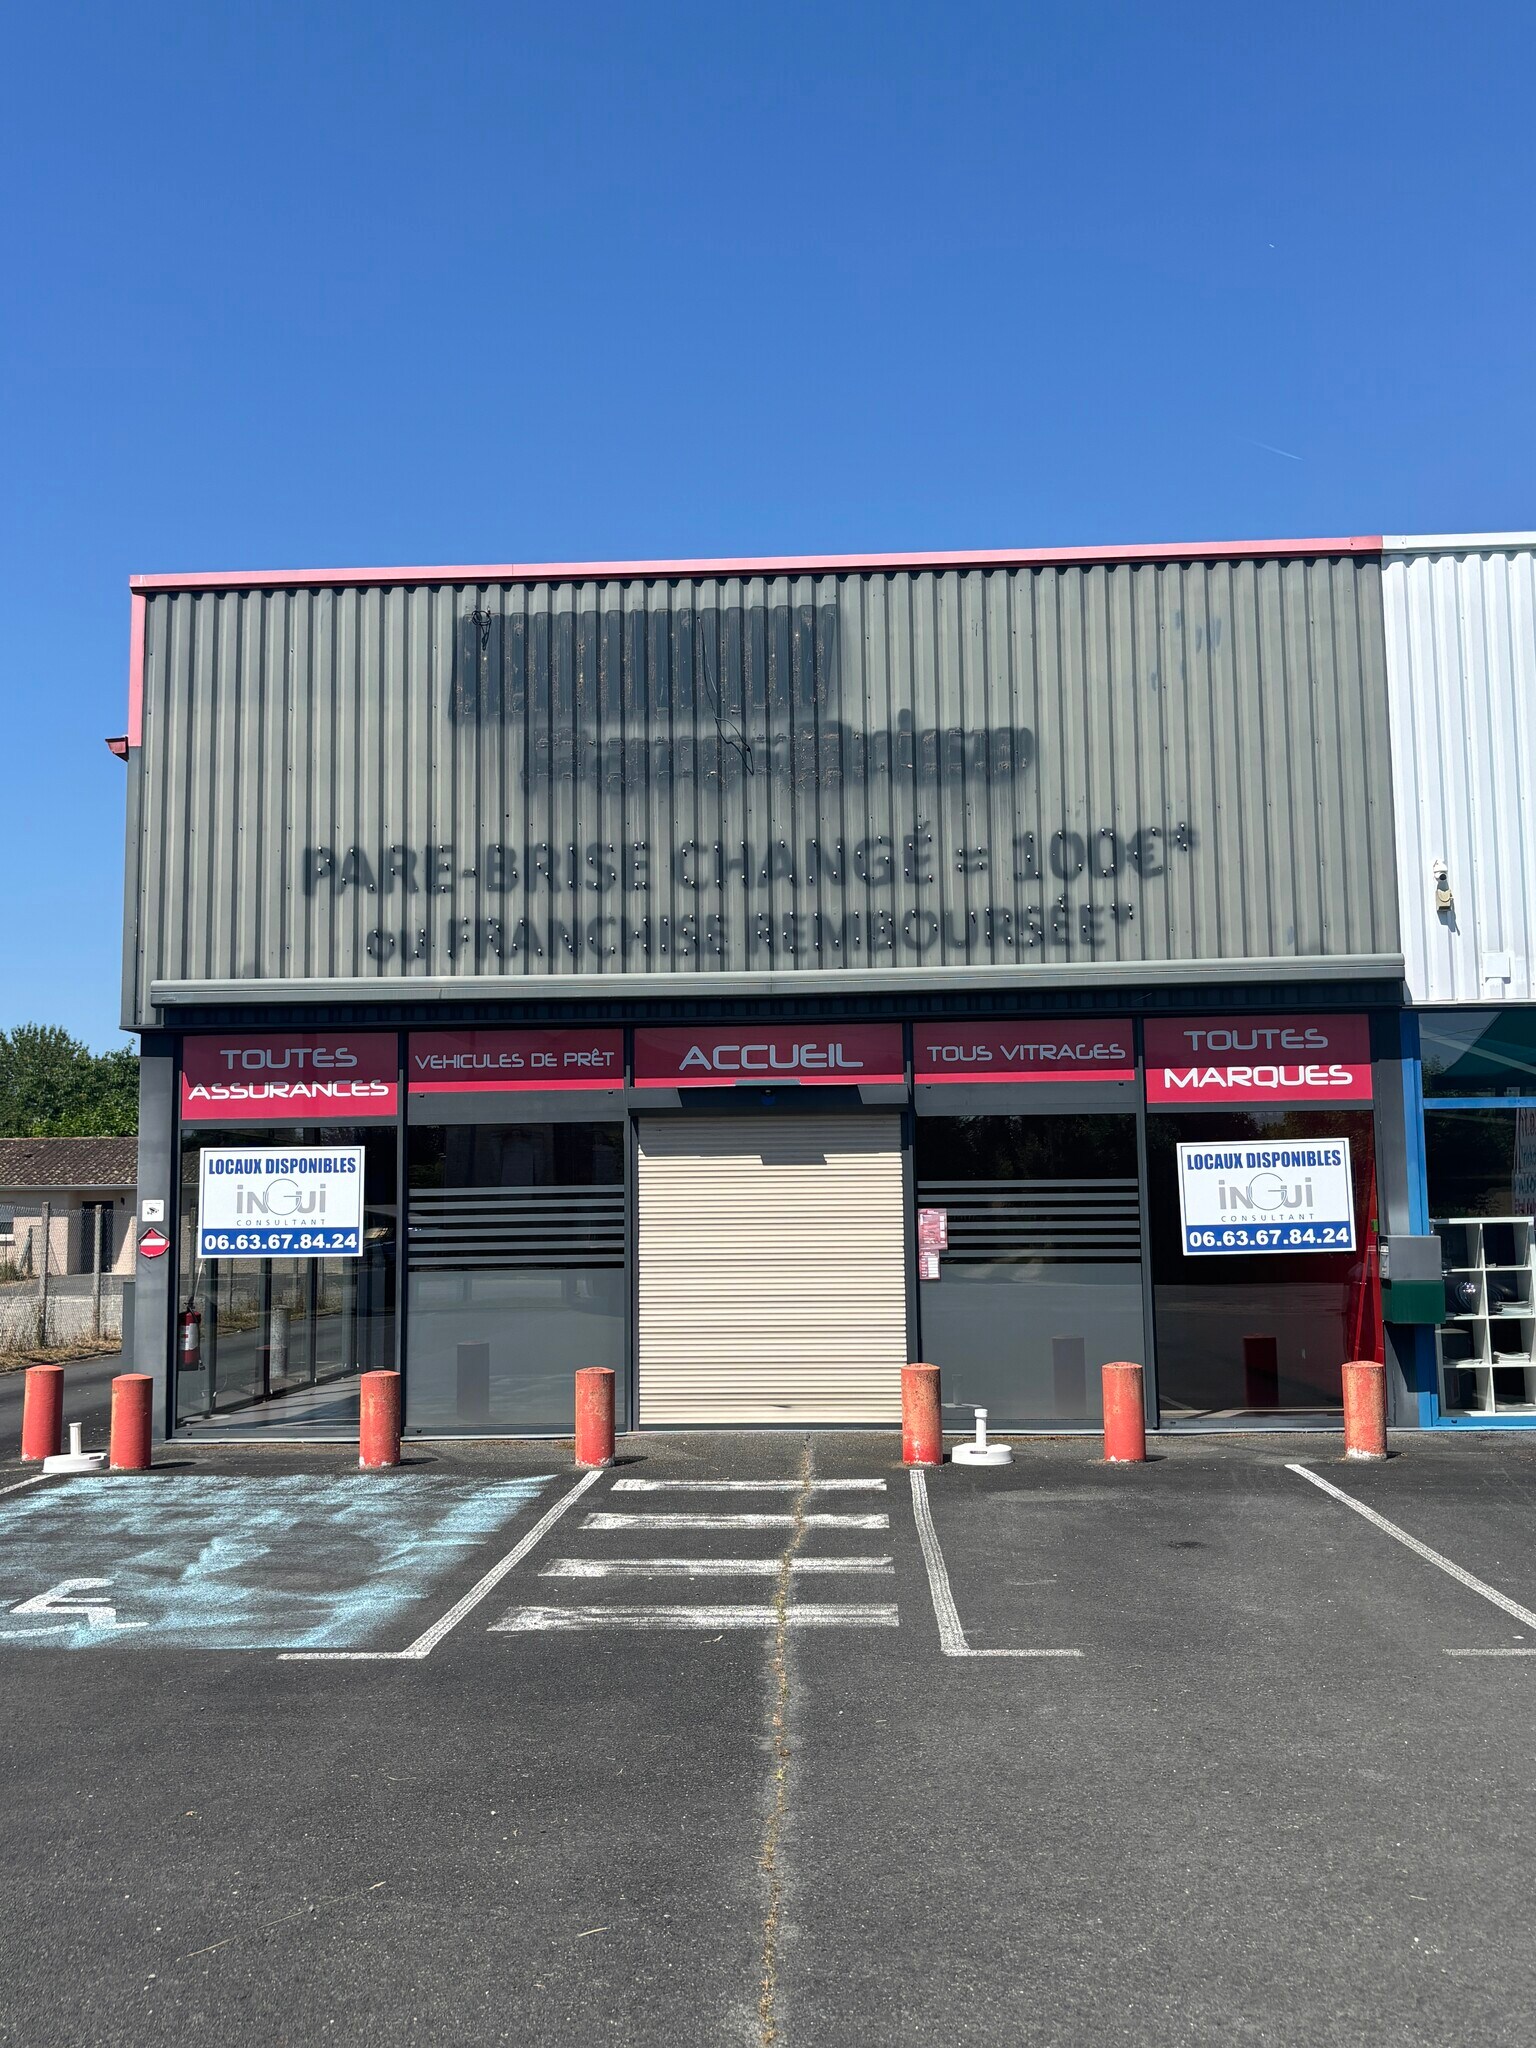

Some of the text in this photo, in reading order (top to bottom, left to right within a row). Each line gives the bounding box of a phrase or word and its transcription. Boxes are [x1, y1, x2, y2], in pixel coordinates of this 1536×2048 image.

[303, 840, 652, 897] PARE-BRISE
[676, 821, 932, 891] CHANGÉ
[448, 914, 726, 961] FRANCHISE
[1183, 1028, 1329, 1051] TOUTES
[220, 1046, 358, 1071] TOUTES
[415, 1047, 615, 1070] VEHICULES DE PRÊT
[678, 1043, 864, 1071] ACCUEIL
[926, 1043, 1126, 1062] TOUS VITRAGES
[1164, 1064, 1353, 1088] MARQUES
[188, 1079, 389, 1101] ASSURANCES
[208, 1157, 356, 1175] LOCAUX DISPONIBLES
[1186, 1149, 1342, 1171] LOCAUX DISPONIBLES
[236, 1218, 326, 1227] CONSULTANT
[1220, 1212, 1315, 1223] CONSULTANT
[204, 1233, 357, 1250] 06.63.67.84.24
[1189, 1227, 1349, 1247] 06.63.67.84.24
